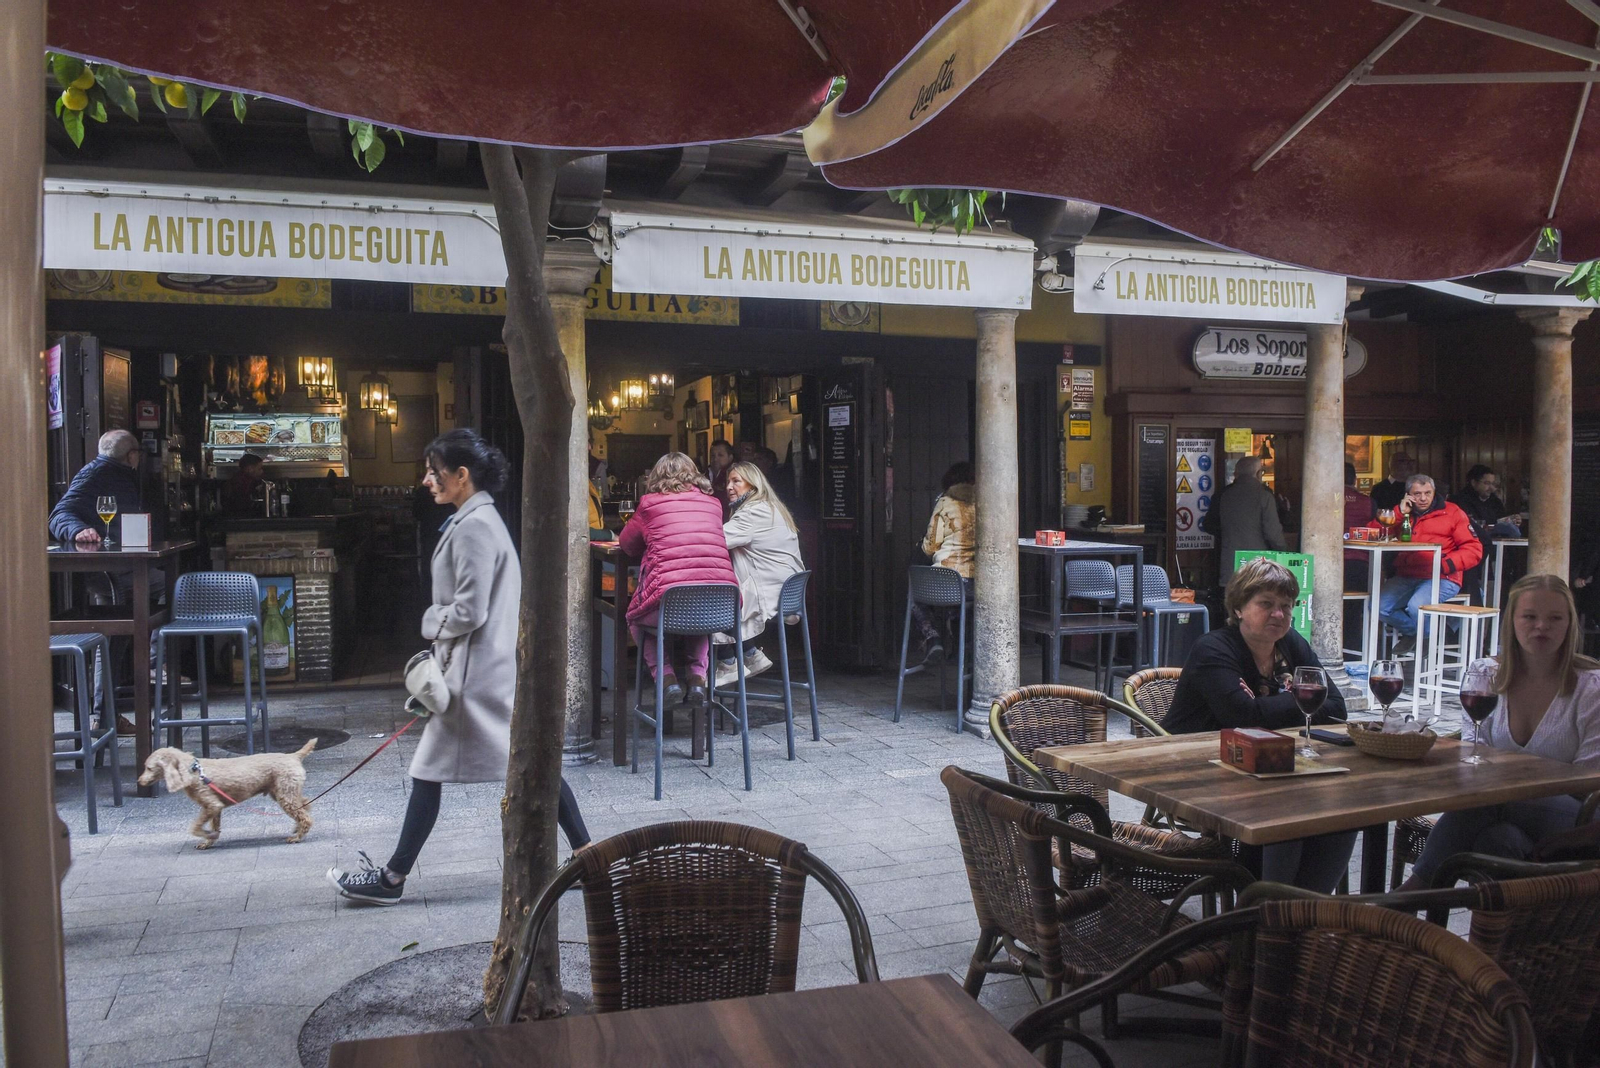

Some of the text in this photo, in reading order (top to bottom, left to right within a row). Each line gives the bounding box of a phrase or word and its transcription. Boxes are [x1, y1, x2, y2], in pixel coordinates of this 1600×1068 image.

[94, 212, 449, 267] LA ANTIGUA BODEGUITA
[703, 246, 970, 291] LA ANTIGUA BODEGUITA
[479, 286, 682, 313] BGUITA
[1115, 271, 1317, 309] LA ANTIGUA BODEGUITA
[1215, 332, 1250, 355] Los
